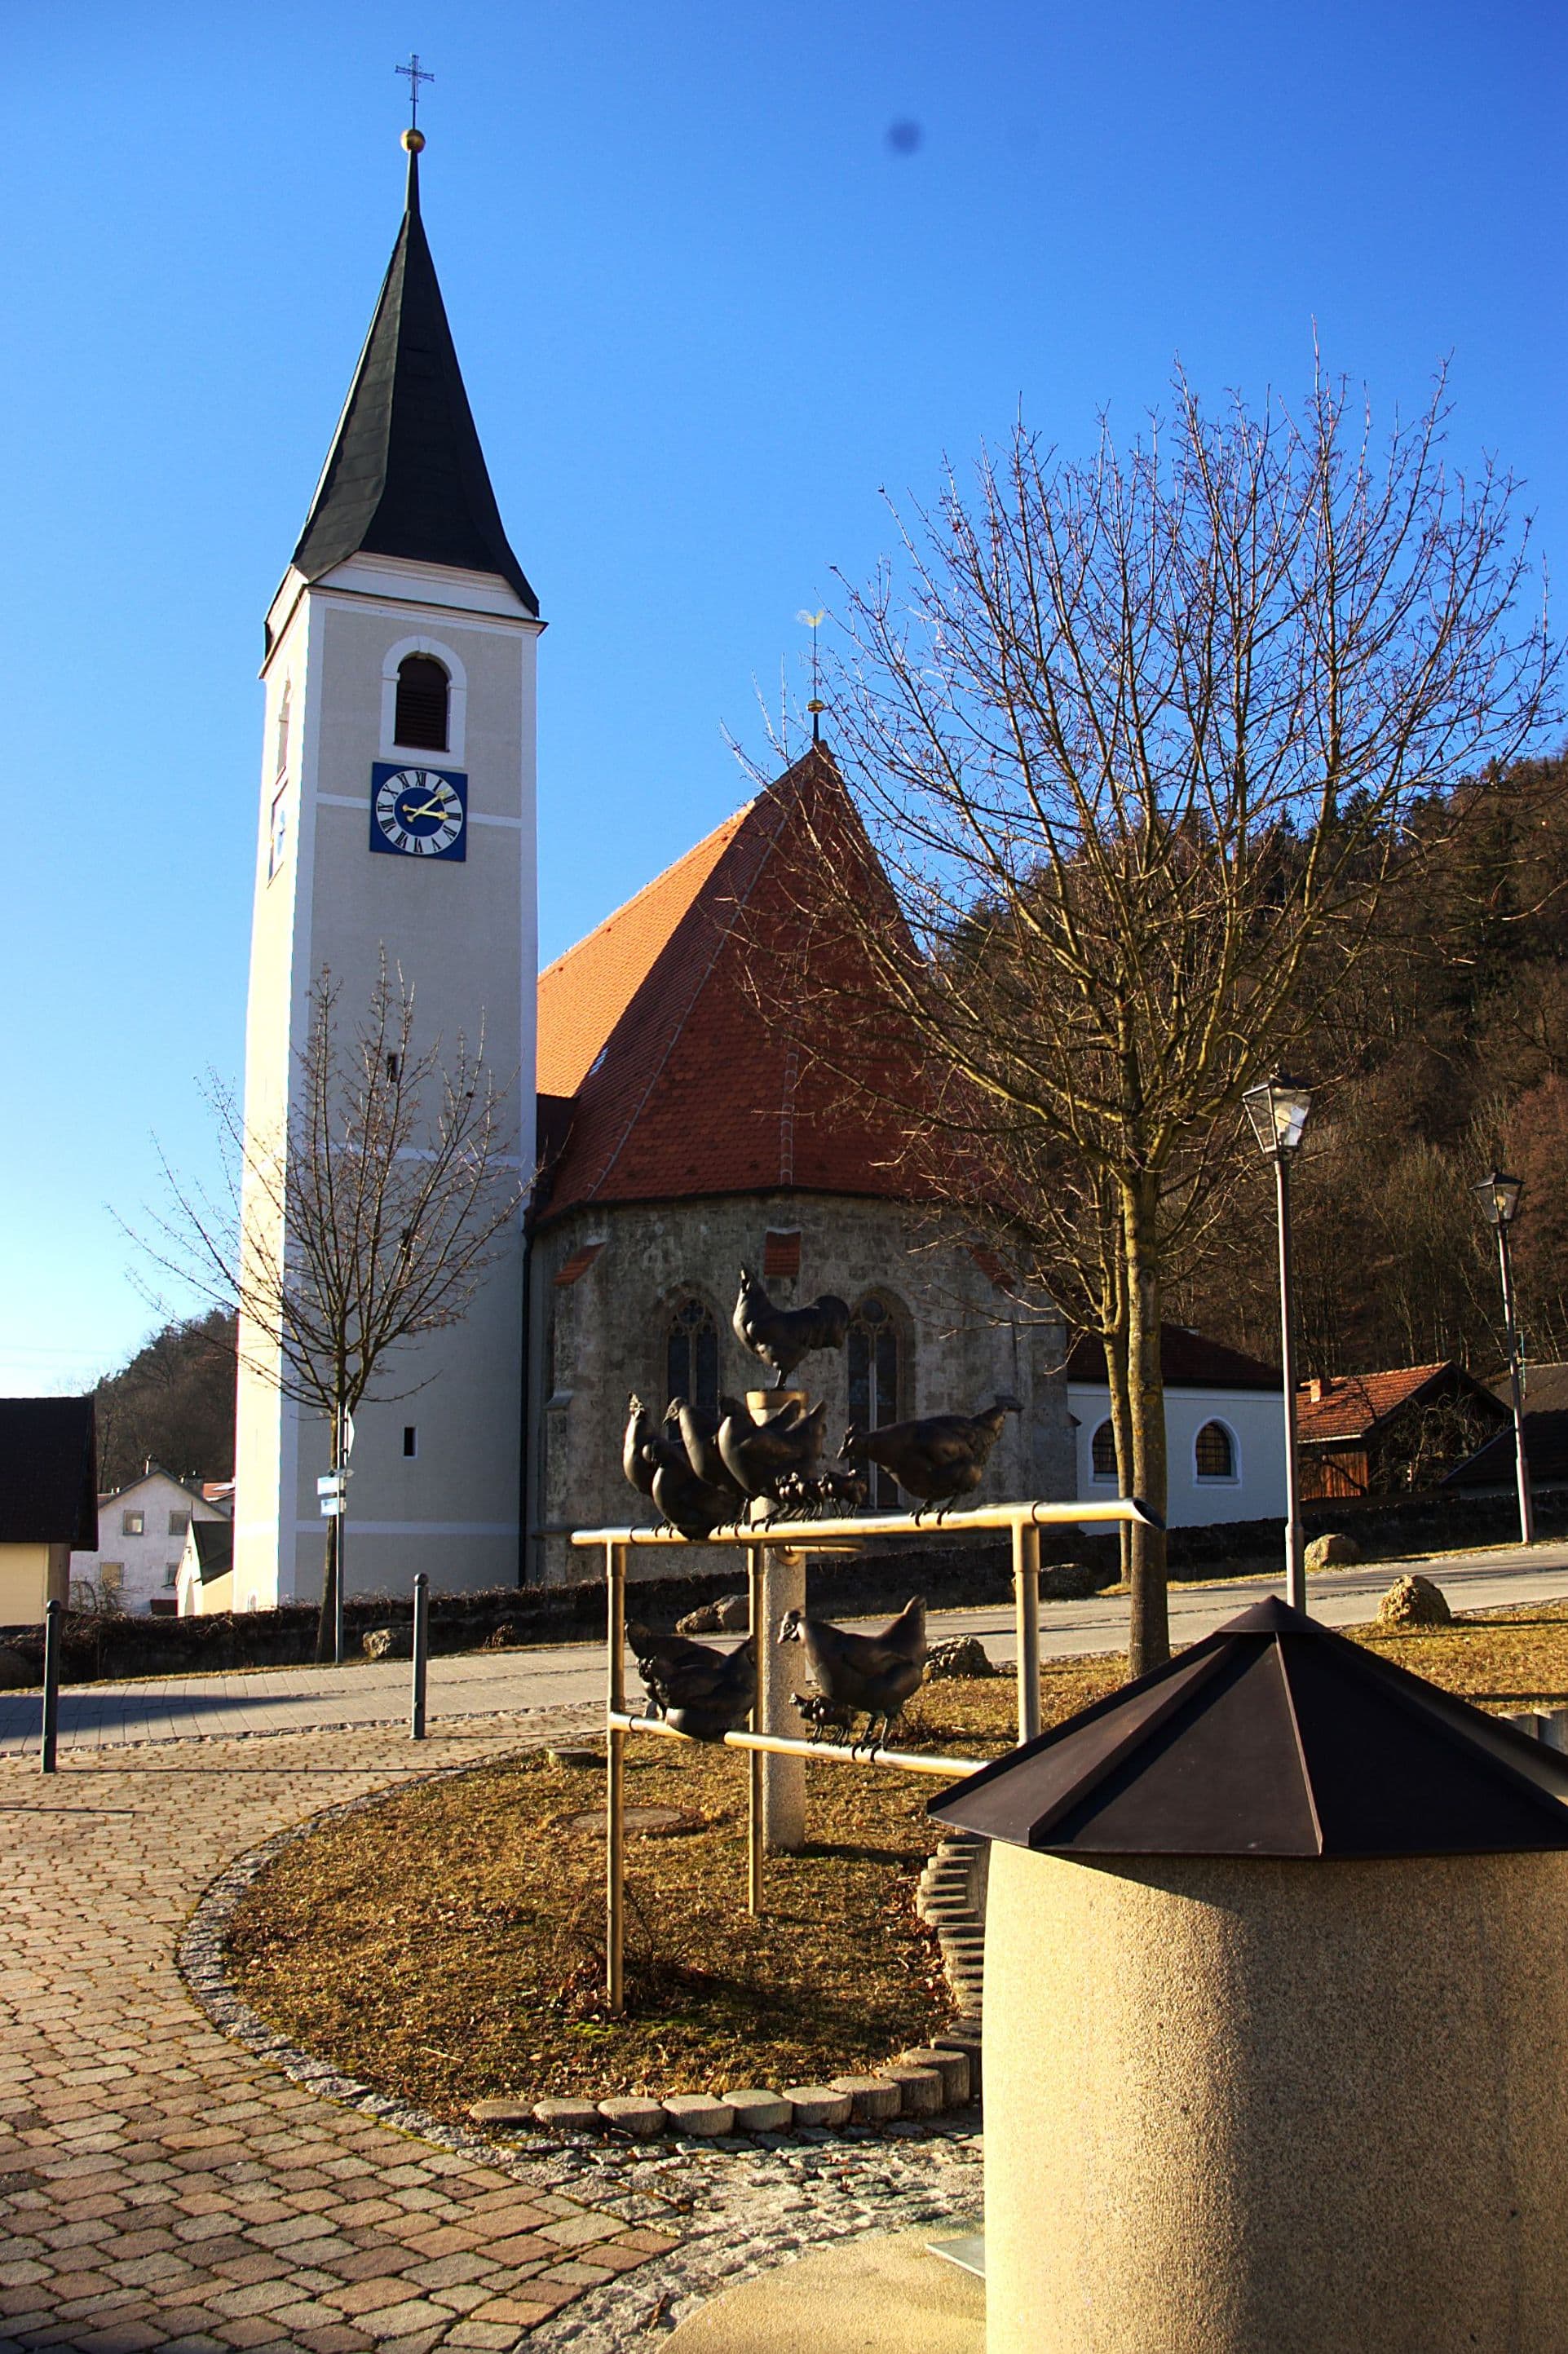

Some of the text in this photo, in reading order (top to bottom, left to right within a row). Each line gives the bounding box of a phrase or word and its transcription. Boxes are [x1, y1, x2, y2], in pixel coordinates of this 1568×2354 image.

[415, 771, 427, 787] XII
[433, 779, 443, 792] I
[382, 784, 398, 799] X
[378, 802, 393, 812] IX
[413, 838, 423, 853] VI
[431, 837, 441, 851] V
